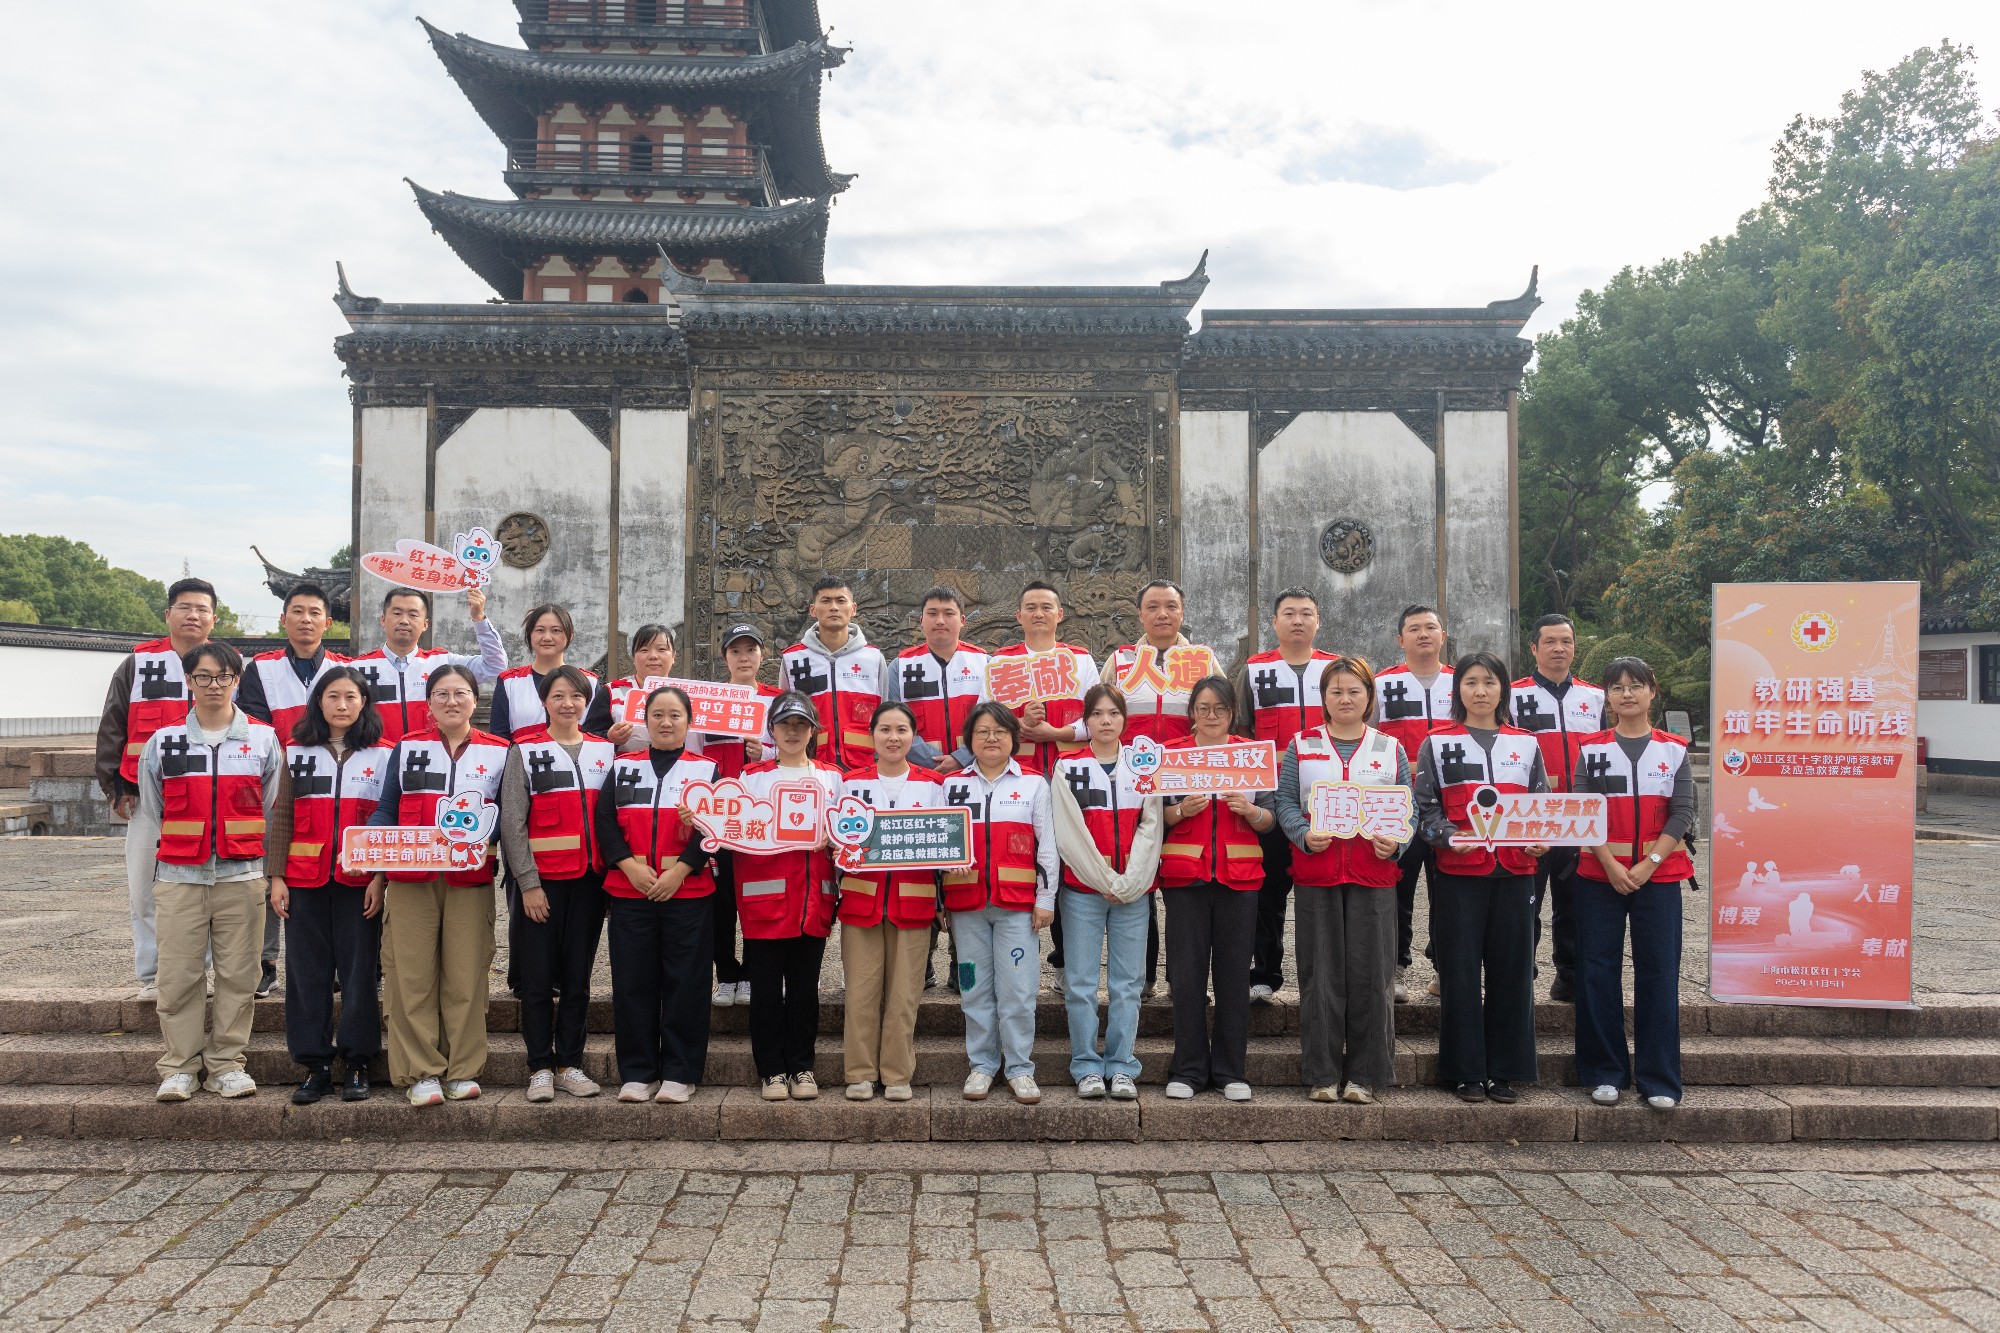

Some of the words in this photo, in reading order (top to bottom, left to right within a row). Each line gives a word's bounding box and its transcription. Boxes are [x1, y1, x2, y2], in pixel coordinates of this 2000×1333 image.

[409, 549, 457, 571] 红十字
[990, 651, 1077, 704] 奉献
[1125, 649, 1209, 690] 人道
[1755, 676, 1877, 703] 教研强基
[699, 700, 725, 714] 中立
[730, 703, 756, 717] 独立
[694, 714, 721, 726] 统一
[728, 717, 754, 731] 普遍
[1724, 709, 1909, 736] 筑牢生命防线
[1163, 747, 1268, 769] 人人学急救
[1751, 753, 1895, 766] 松江区红十字救护师资教研
[1160, 771, 1266, 790] 急救为人人
[1780, 765, 1864, 776] 及应急救援演练
[696, 797, 742, 816] AED
[1313, 785, 1409, 838] 博爱
[1504, 798, 1602, 818] 人人学急救
[724, 818, 767, 841] 急救
[880, 817, 948, 831] 松江区红十字
[1504, 819, 1600, 839] 急救为人人
[368, 830, 432, 844] 教研强基
[880, 832, 949, 845] 救护师资教研
[351, 847, 447, 862] 筑牢生命防线
[880, 847, 961, 861] 及应急救援演练
[1853, 883, 1901, 903] 人道
[1718, 905, 1762, 926] 博爱
[1860, 937, 1908, 958] 奉献
[1760, 964, 1861, 978] 上海市松江区红十字会
